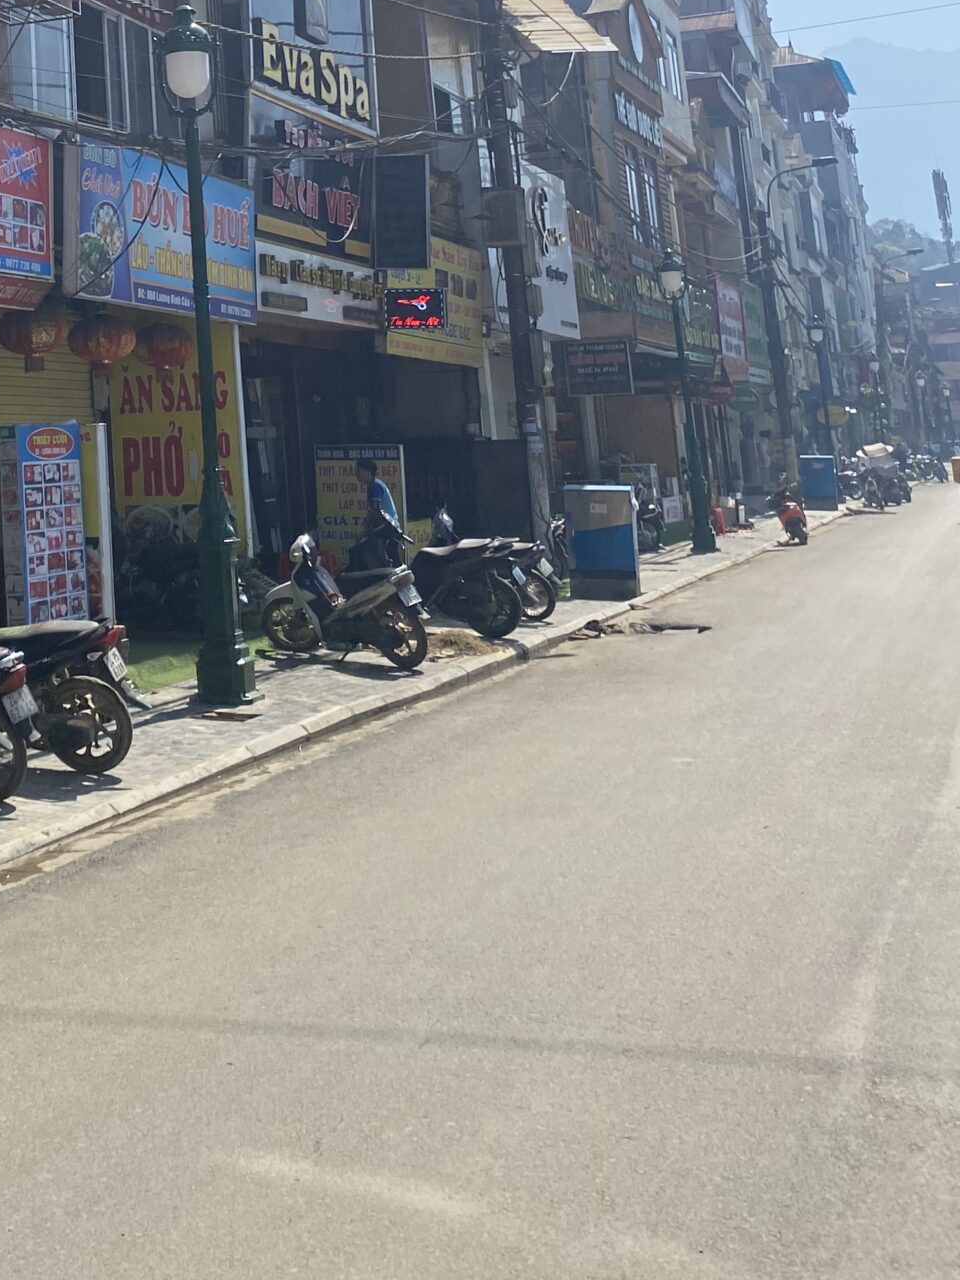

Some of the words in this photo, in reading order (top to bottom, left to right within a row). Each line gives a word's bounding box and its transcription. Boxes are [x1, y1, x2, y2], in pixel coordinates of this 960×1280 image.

[262, 18, 317, 98] Eva
[320, 51, 371, 121] Spa
[130, 172, 180, 233] BÚN
[211, 196, 252, 251] HUẾ
[119, 363, 153, 415] ĂN
[121, 420, 186, 498] PHỞ
